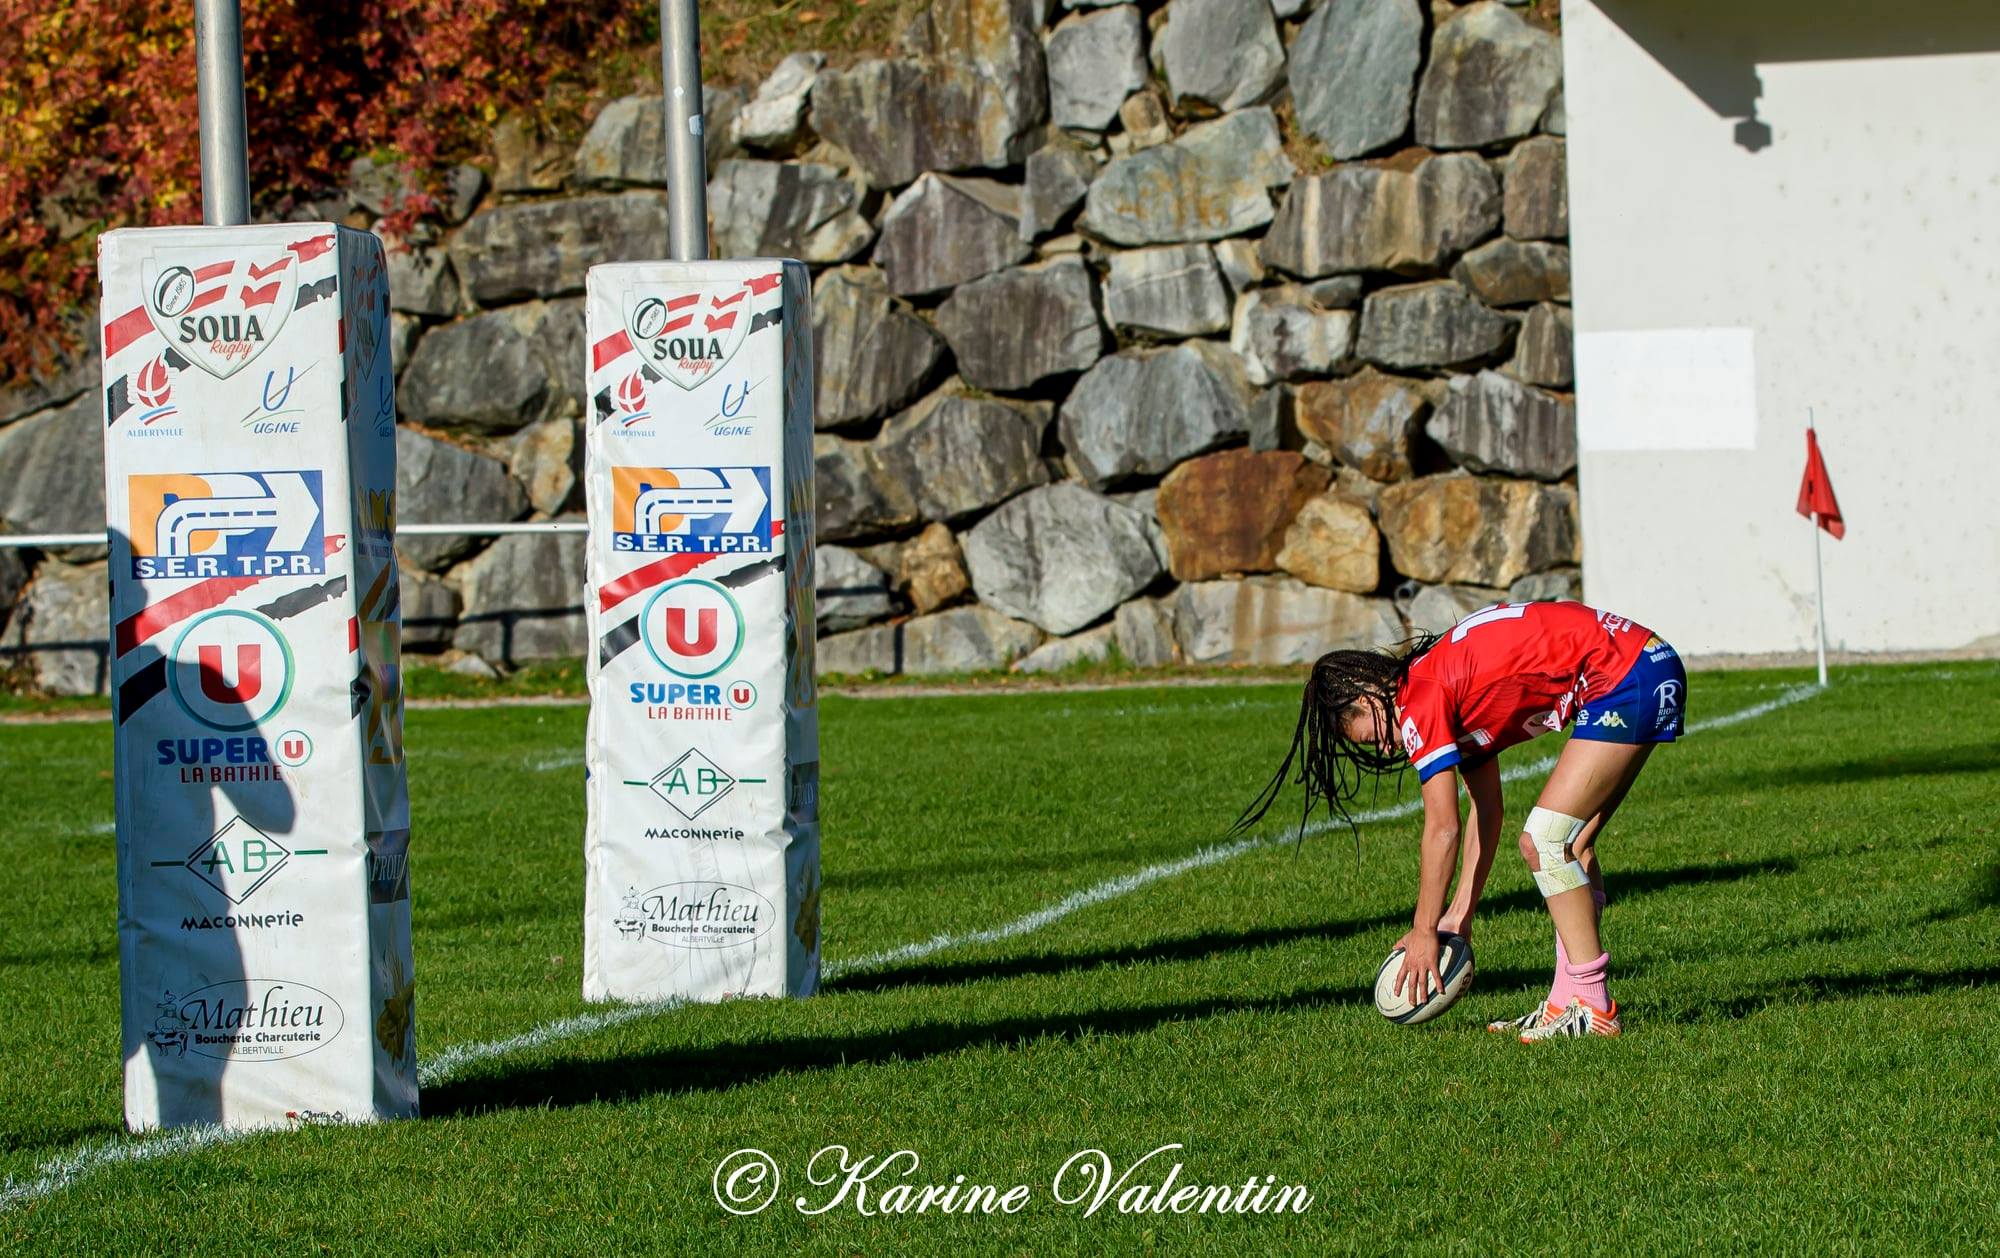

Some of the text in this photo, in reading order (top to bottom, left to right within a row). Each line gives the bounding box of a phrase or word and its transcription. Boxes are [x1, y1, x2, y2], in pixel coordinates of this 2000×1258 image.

[179, 315, 264, 343] SOUA
[210, 339, 253, 360] Rugby
[653, 338, 723, 360] SOUA
[678, 357, 714, 374] Rugby
[127, 428, 183, 437] ALBERTVILLE
[253, 422, 300, 434] UGINE
[612, 430, 655, 438] ALBERTVILLE
[714, 426, 752, 436] UGINE
[616, 534, 768, 552] S.E.R. T.P.R.
[136, 555, 321, 578] S.E.R. T.P.R.
[666, 608, 718, 657] U
[198, 644, 261, 703] U
[630, 683, 750, 705] SUPER U
[648, 706, 732, 720] LA BATHIE
[156, 736, 304, 765] SUPER U
[181, 765, 282, 784] LA BATHIE
[642, 888, 759, 922] Mathieu
[652, 923, 756, 934] Boucherie Charcuterie
[681, 936, 725, 944] ALBERTVILLE
[180, 986, 325, 1031] Mathieu
[195, 1031, 321, 1044] Boucherie Charcuterie
[232, 1045, 284, 1055] ALBERTVILLE
